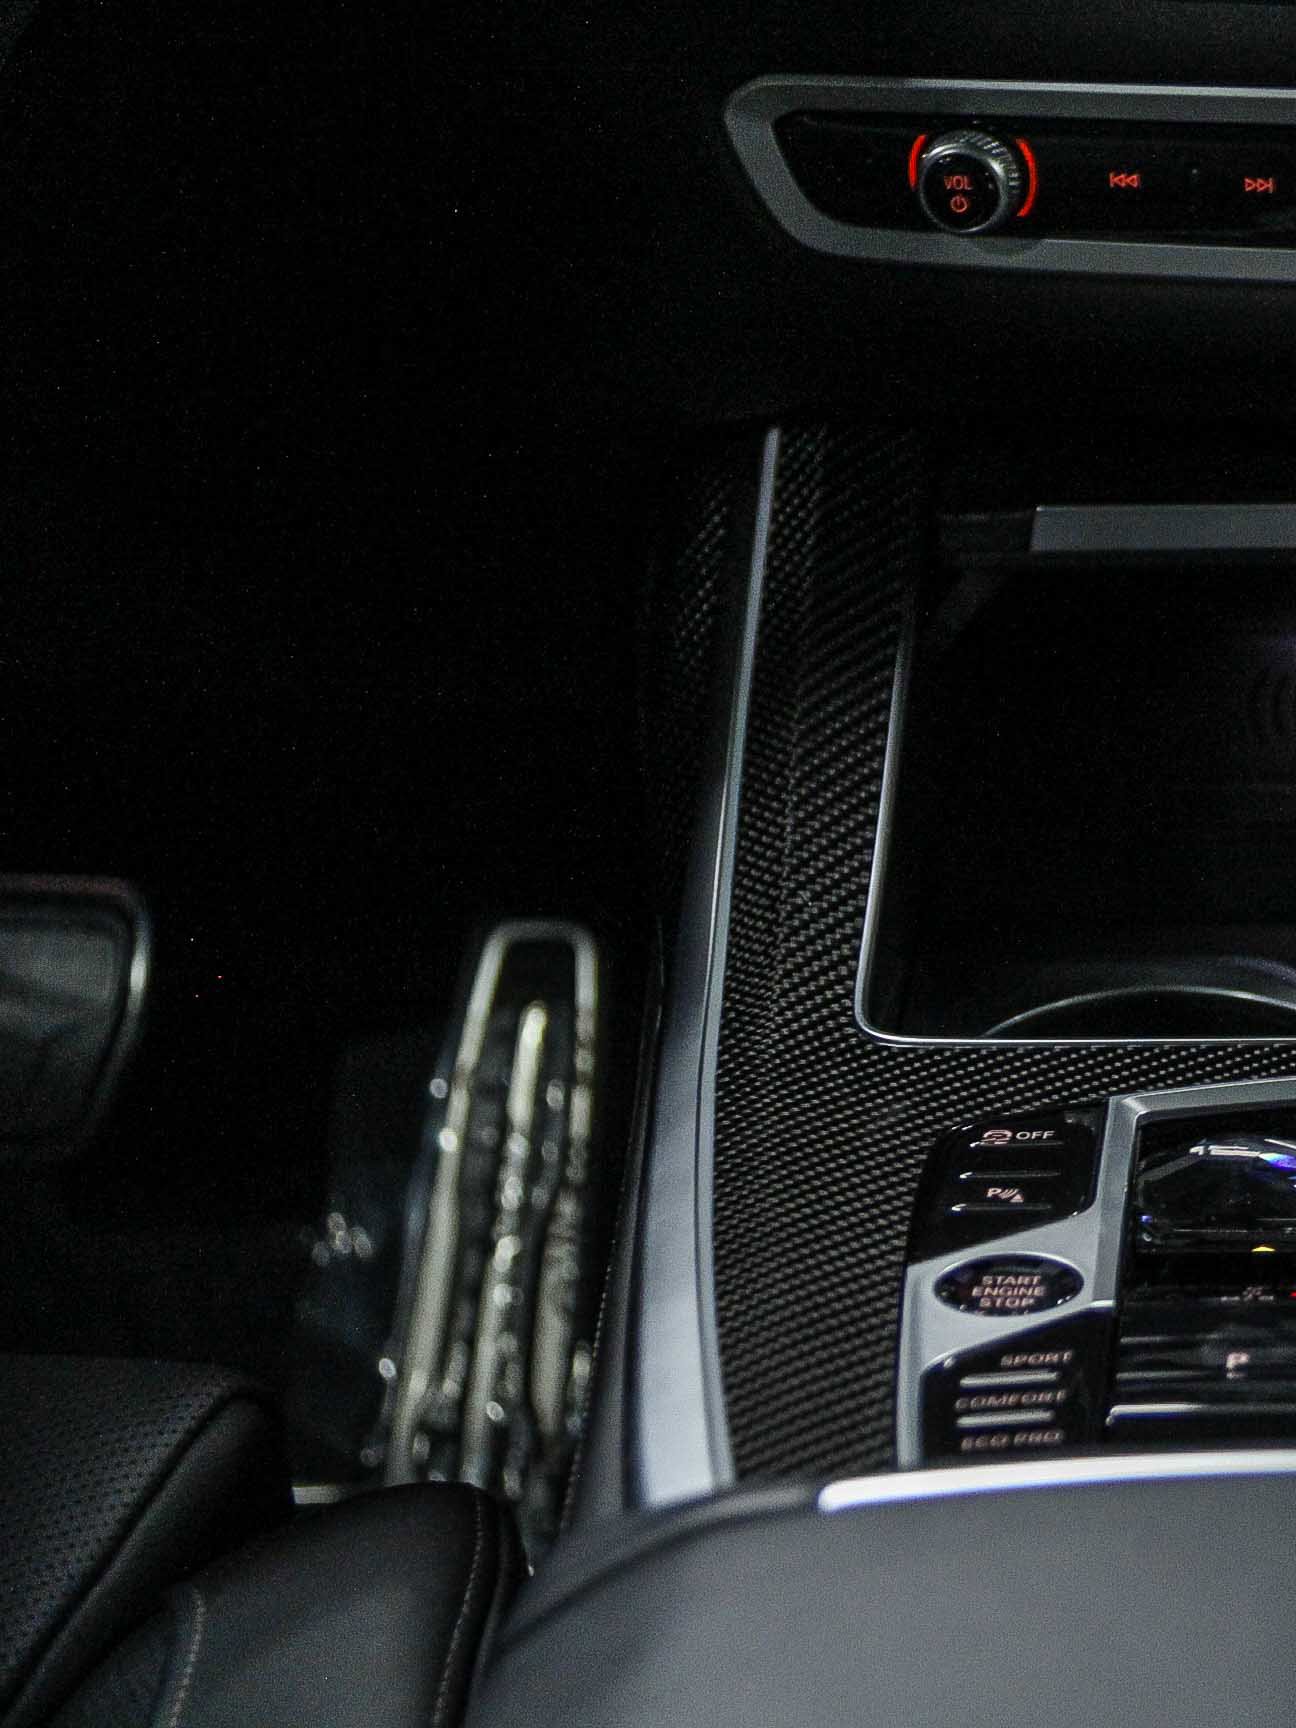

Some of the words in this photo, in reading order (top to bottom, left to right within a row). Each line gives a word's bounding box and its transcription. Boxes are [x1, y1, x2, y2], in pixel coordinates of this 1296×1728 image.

[944, 175, 975, 190] VOL
[1016, 1130, 1055, 1141] OFF
[981, 1274, 1041, 1286] START
[972, 1286, 1047, 1297] ENGINE
[979, 1297, 1035, 1309] STOP
[1001, 1351, 1073, 1367] SPORT
[955, 1390, 1067, 1410] COMFORT
